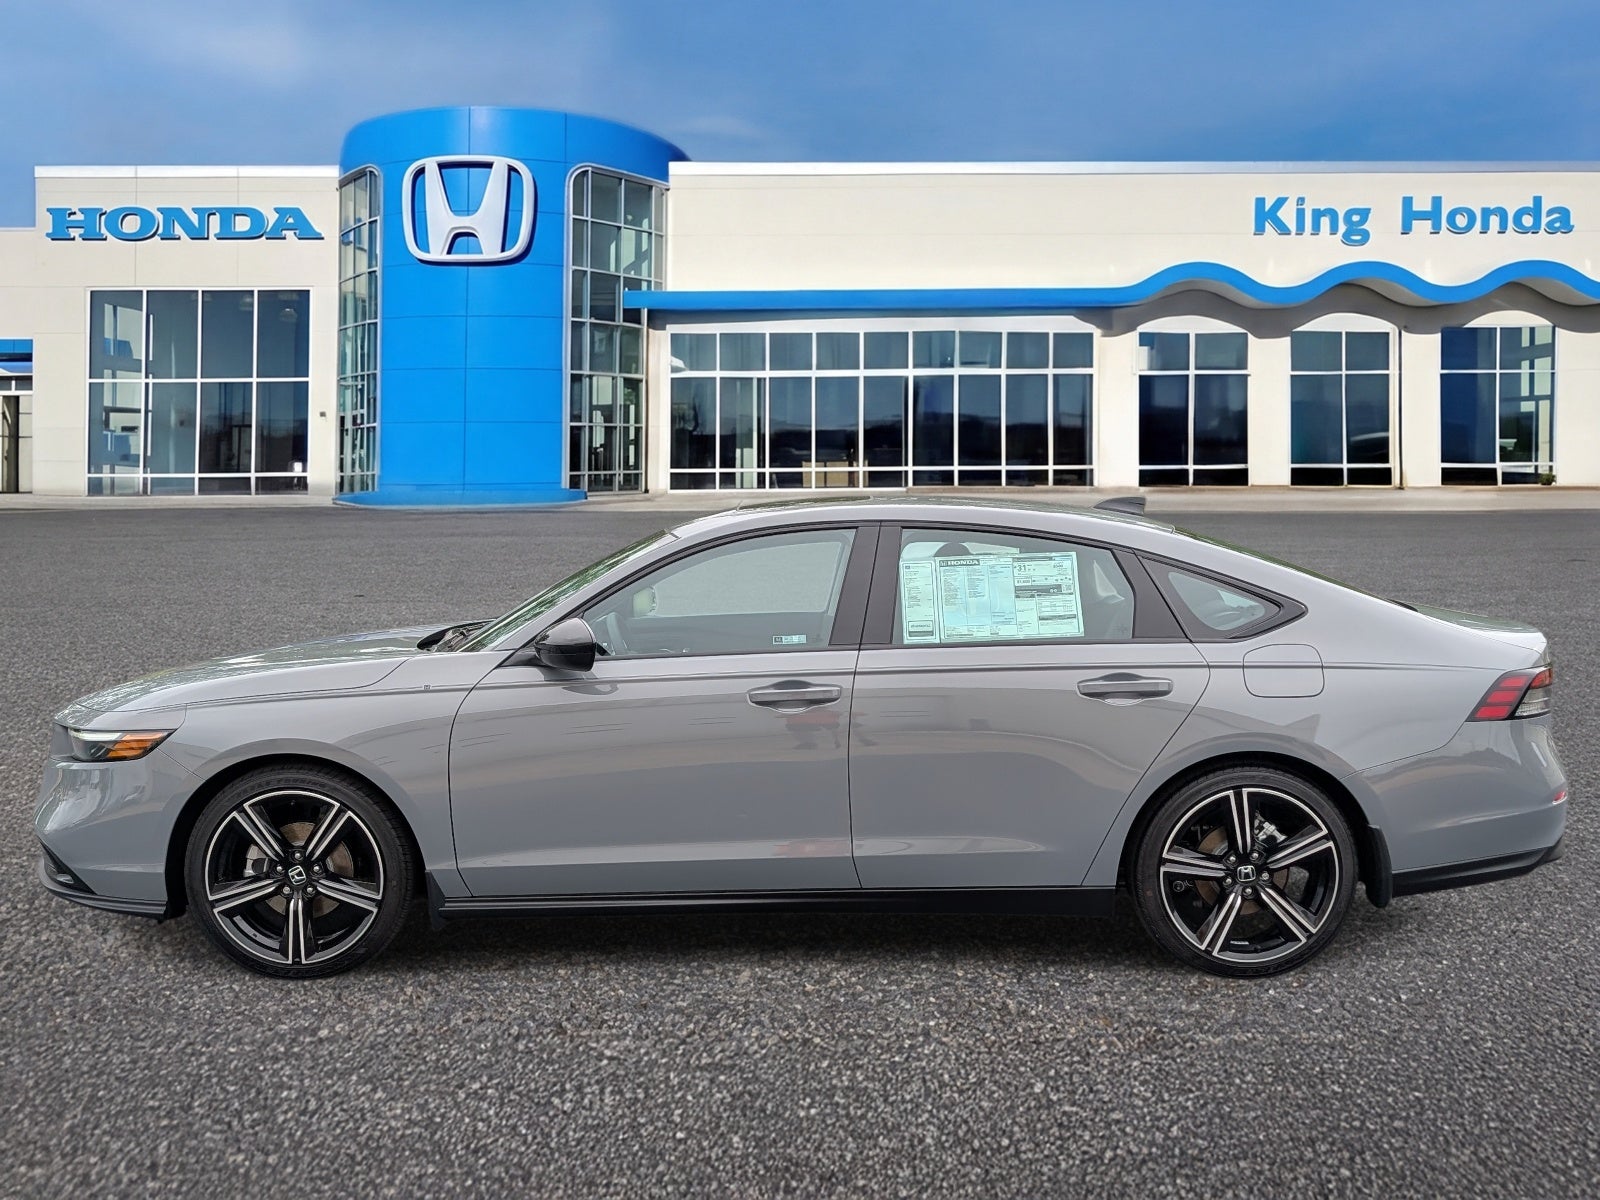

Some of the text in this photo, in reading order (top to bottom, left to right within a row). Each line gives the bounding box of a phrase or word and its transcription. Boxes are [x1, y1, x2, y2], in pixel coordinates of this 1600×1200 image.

[45, 206, 325, 241] HONDA
[1253, 196, 1575, 246] King Honda
